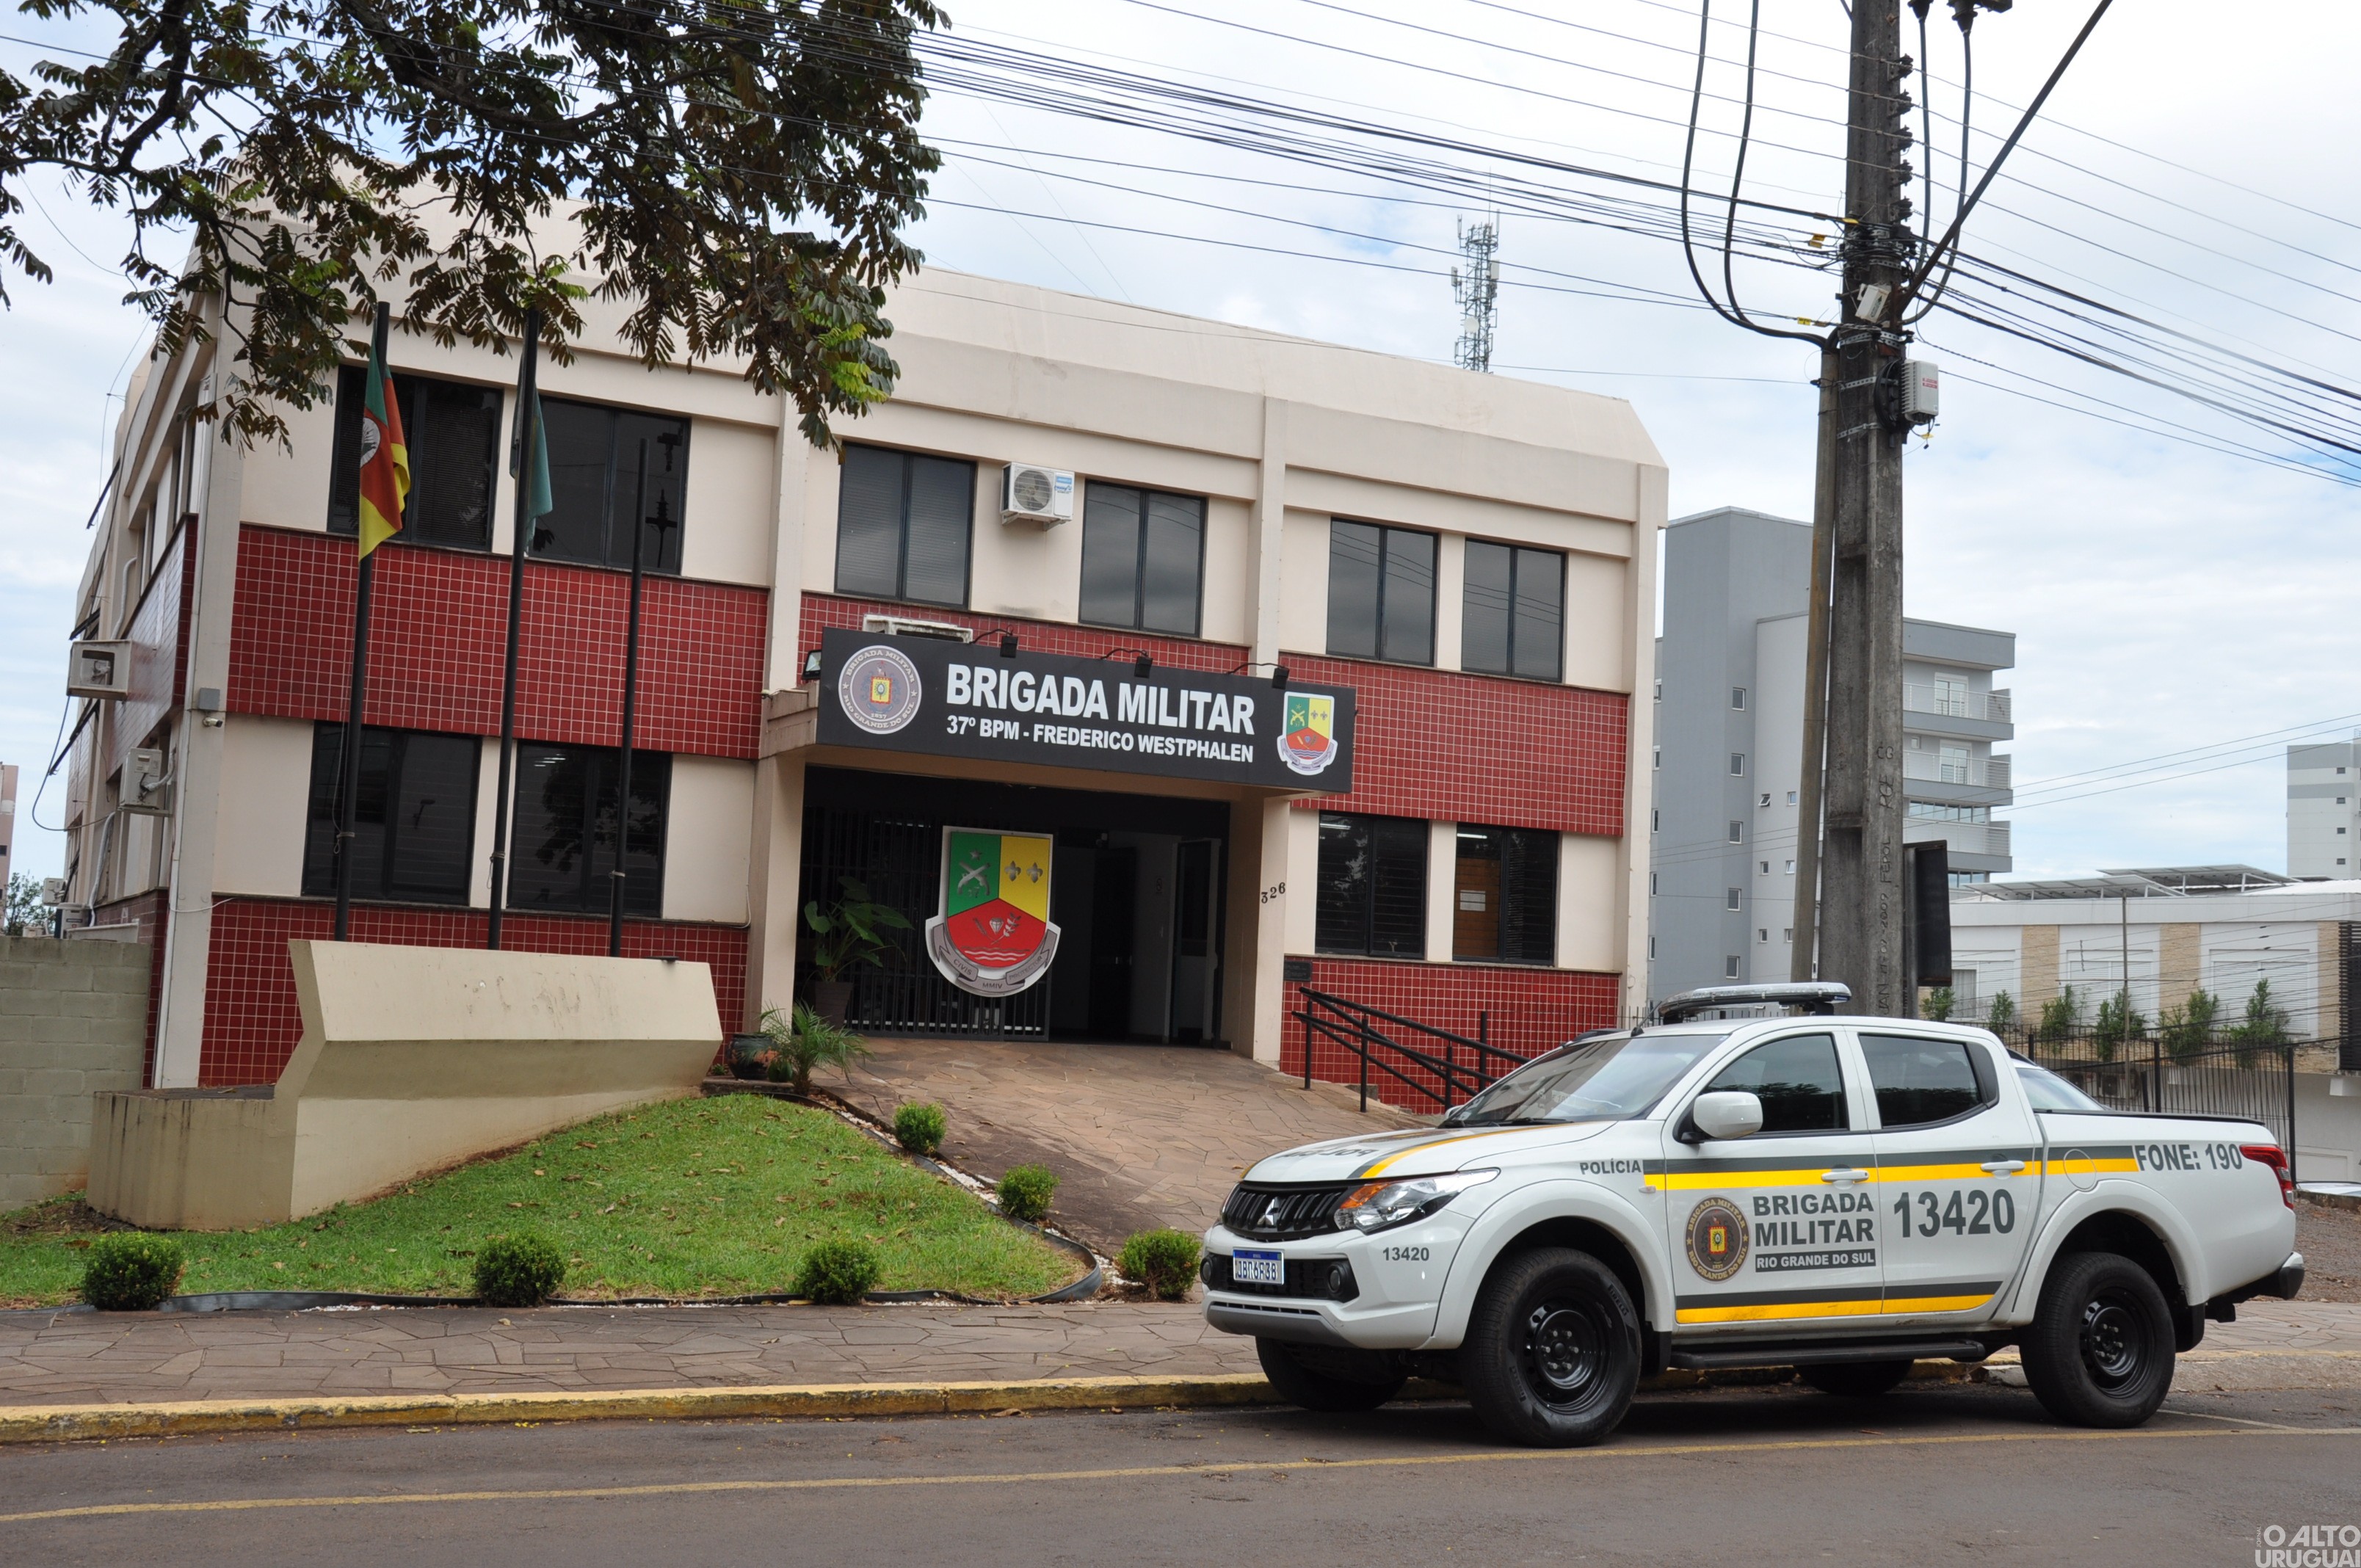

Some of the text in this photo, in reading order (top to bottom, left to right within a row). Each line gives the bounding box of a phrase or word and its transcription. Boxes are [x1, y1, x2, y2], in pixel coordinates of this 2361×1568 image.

[846, 650, 915, 683] BRIGADA MILITAR
[843, 694, 915, 728] RIO GRANDE DO SUL
[946, 663, 1255, 736] BRIGADA MILITAR
[946, 715, 976, 735] 37º
[979, 718, 1020, 740] BPM
[1033, 724, 1134, 751] FREDERICO
[1137, 734, 1254, 763] WESTPHALEN
[1261, 882, 1286, 904] 326
[953, 959, 973, 976] CIVIS
[1579, 1158, 1642, 1175] POLÍCIA
[2134, 1143, 2243, 1171] FONE: 190
[1688, 1199, 1746, 1231] BRIGADA MILITAR
[1752, 1192, 1874, 1216] BRIGADA
[1893, 1188, 2015, 1238] 13420
[1755, 1219, 1875, 1247] MILITAR
[1382, 1246, 1430, 1262] 13420
[1689, 1246, 1747, 1280] RIO GRANDE DO SUL
[1756, 1252, 1874, 1269] RIO GRANDE DO SUL
[1237, 1260, 1277, 1281] JBR6F38
